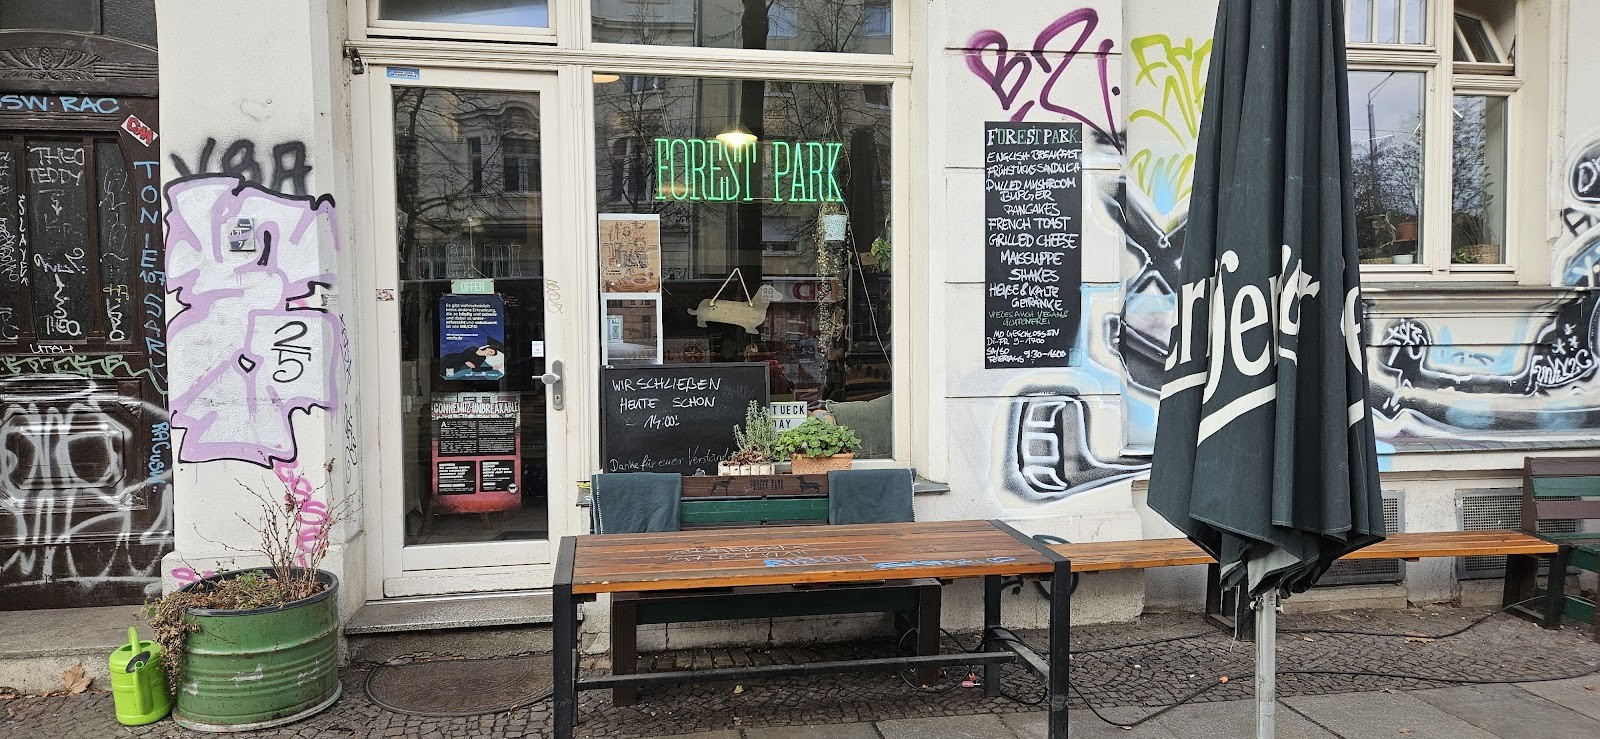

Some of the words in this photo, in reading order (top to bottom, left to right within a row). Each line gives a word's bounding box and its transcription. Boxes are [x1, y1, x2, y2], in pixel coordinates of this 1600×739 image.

[987, 126, 1042, 146] FOREST
[1043, 128, 1081, 145] PARK
[986, 150, 1030, 163] ENGLISH
[27, 167, 84, 187] TEDDY
[654, 137, 758, 202] FOREST
[772, 140, 844, 203] PARK
[986, 178, 1023, 192] PULLED
[1024, 176, 1077, 191] MUSHROOM
[999, 189, 1056, 202] BURGER
[1003, 202, 1061, 217] PANCAKES
[987, 216, 1032, 231] FRENCH
[1032, 216, 1072, 231] TOAST
[988, 233, 1035, 248] GRILLED
[1035, 233, 1080, 249] CHEESE
[1008, 267, 1060, 283] SHAKES
[460, 281, 485, 292] OFFEN
[612, 378, 636, 392] WIR
[619, 397, 660, 413] HEUTE
[672, 396, 716, 409] SCHON
[609, 458, 640, 473] Danke
[640, 454, 655, 470] für
[658, 456, 685, 467] euer
